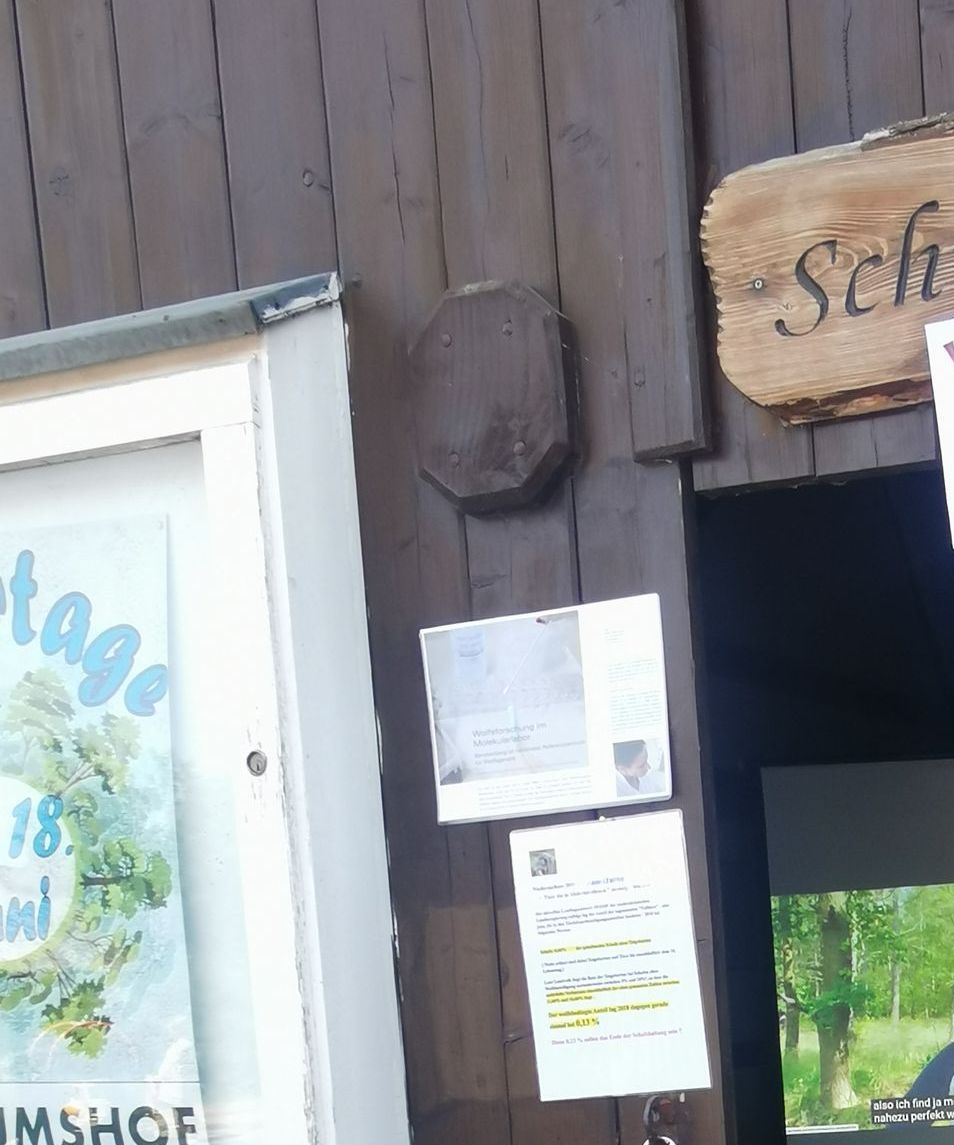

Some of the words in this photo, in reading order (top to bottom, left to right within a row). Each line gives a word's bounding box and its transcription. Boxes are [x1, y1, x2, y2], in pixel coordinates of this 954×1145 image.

[0, 549, 168, 717] tage
[0, 875, 51, 943] ni
[873, 1101, 894, 1111] also
[896, 1099, 911, 1110] ich
[912, 1097, 931, 1109] find
[932, 1097, 942, 1110] ja
[874, 1111, 908, 1123] nahezu
[911, 1109, 945, 1123] perfekt
